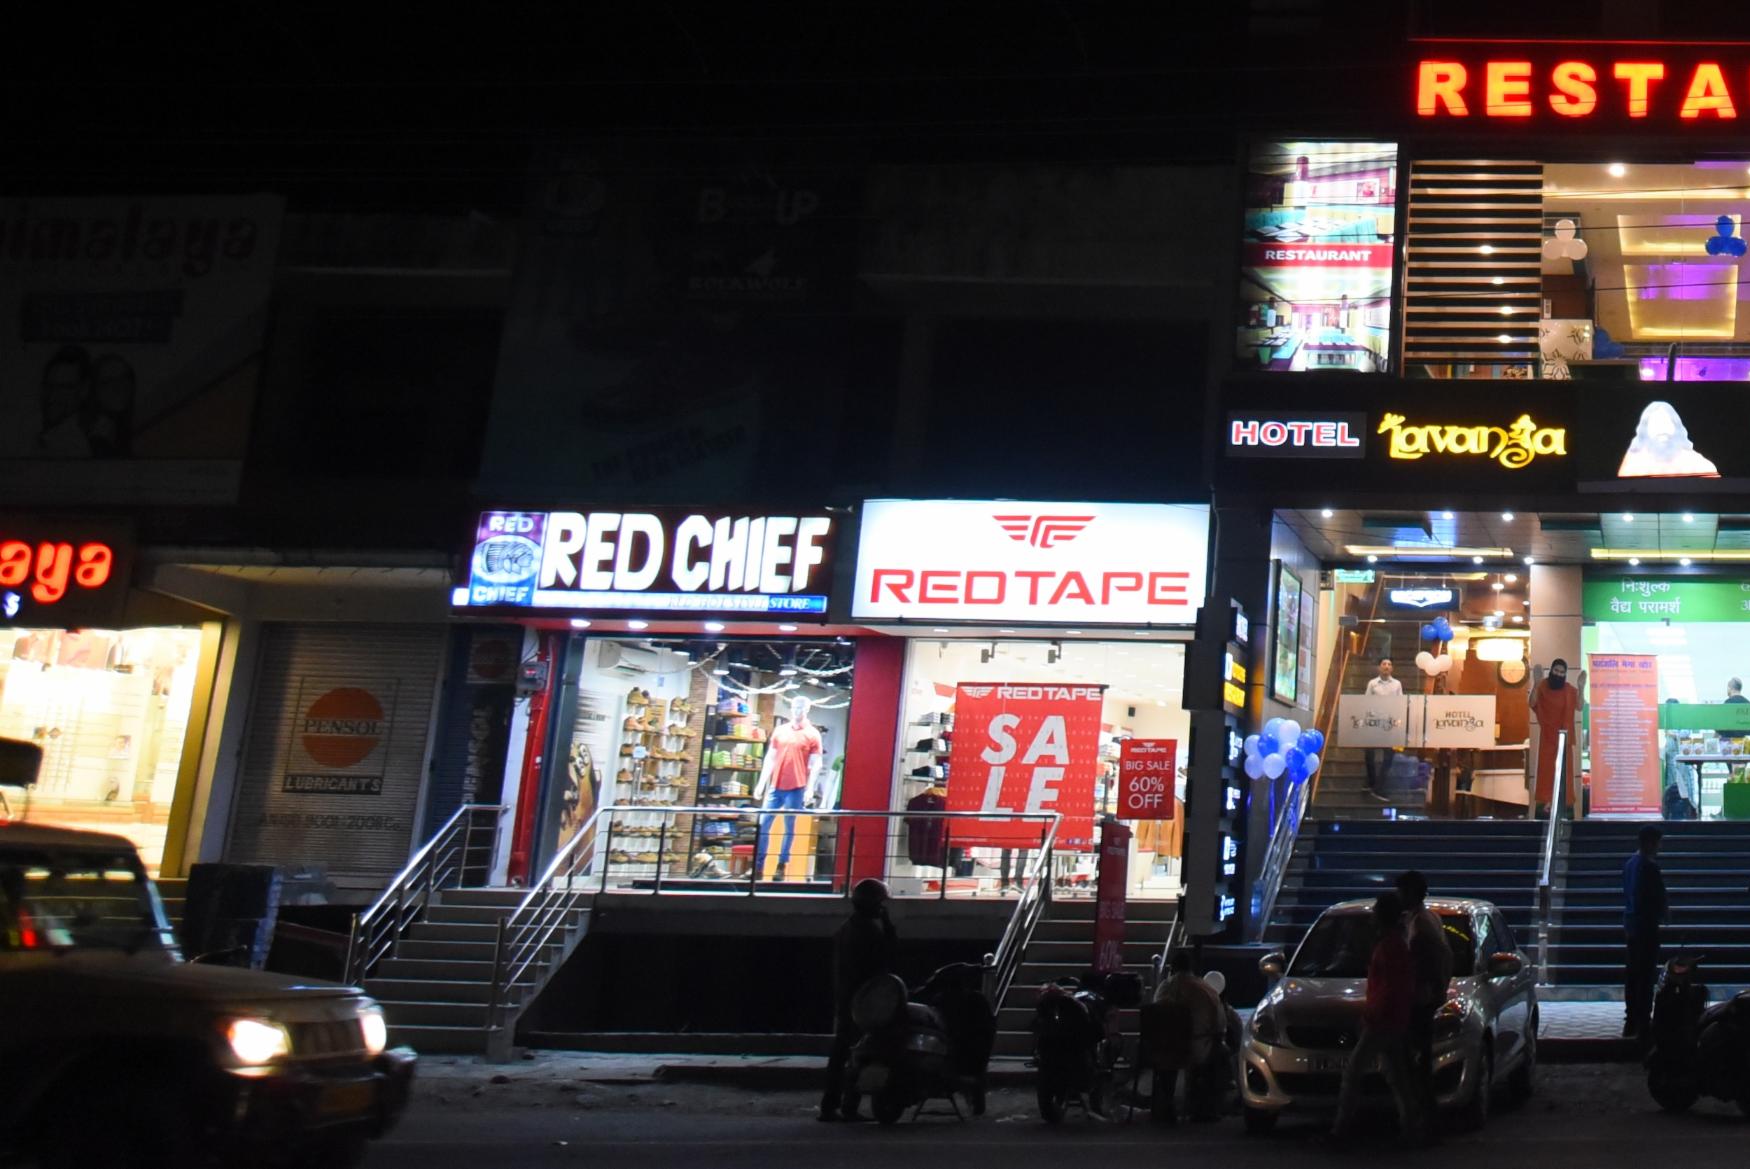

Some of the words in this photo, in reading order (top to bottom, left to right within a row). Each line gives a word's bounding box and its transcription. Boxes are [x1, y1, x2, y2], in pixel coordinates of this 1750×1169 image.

[0, 200, 258, 277] imalaya
[1264, 248, 1372, 262] RESTAURANT
[1230, 419, 1360, 447] HOTEL
[488, 515, 535, 533] RED
[539, 512, 665, 591] RED
[671, 515, 831, 593] CHIEF
[472, 586, 529, 603] CHIEF
[870, 568, 1190, 606] REDTAPE
[769, 598, 811, 610] STORE
[1610, 597, 1632, 614] वैद्य
[1638, 597, 1681, 614] परामर्श
[997, 686, 1102, 701] REDTAPE
[303, 719, 384, 736] PENSOL
[1125, 760, 1144, 771] BIG
[1146, 760, 1171, 771] SALE
[284, 775, 383, 794] LUBRICANTS
[1128, 776, 1165, 792] 60%
[1128, 794, 1164, 809] OFF
